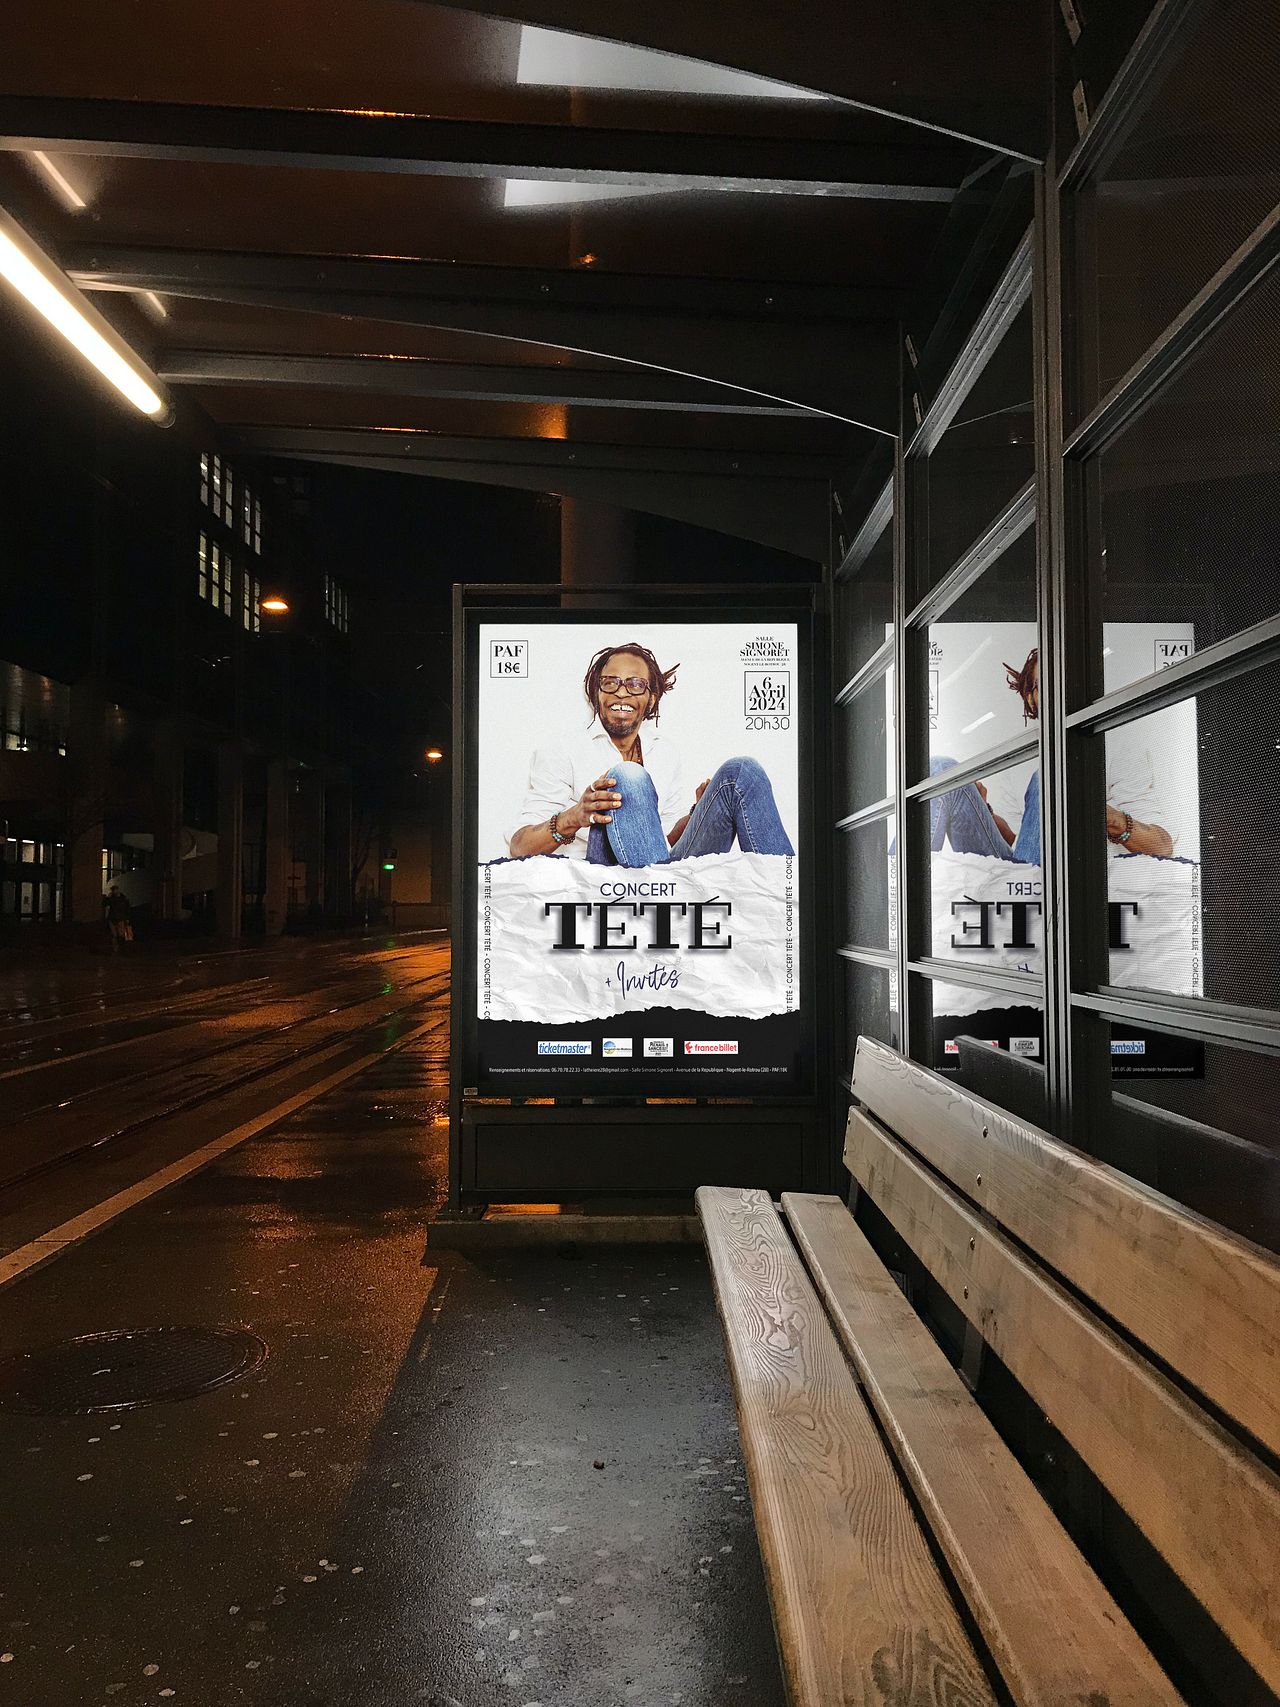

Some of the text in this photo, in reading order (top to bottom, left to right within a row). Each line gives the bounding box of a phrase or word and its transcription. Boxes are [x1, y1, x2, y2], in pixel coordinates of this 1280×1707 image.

[494, 645, 524, 657] PAF
[740, 649, 790, 657] SIGNORET
[745, 642, 785, 650] SIMONE
[497, 661, 520, 674] 18€
[762, 676, 772, 690] 6
[748, 684, 786, 698] Avril
[749, 697, 785, 711] 2024
[745, 716, 790, 730] 20h30
[600, 882, 677, 897] CONCERT
[785, 886, 793, 899] TÉTÉ
[545, 895, 732, 950] TÉTÉ
[484, 938, 492, 951] TÉTÉ
[785, 938, 793, 951] TÉTÉ
[616, 960, 682, 1000] Invités
[484, 990, 492, 1004] TÉTÉ
[785, 990, 793, 1004] TÉTÉ
[539, 1042, 588, 1054] ticketmaster
